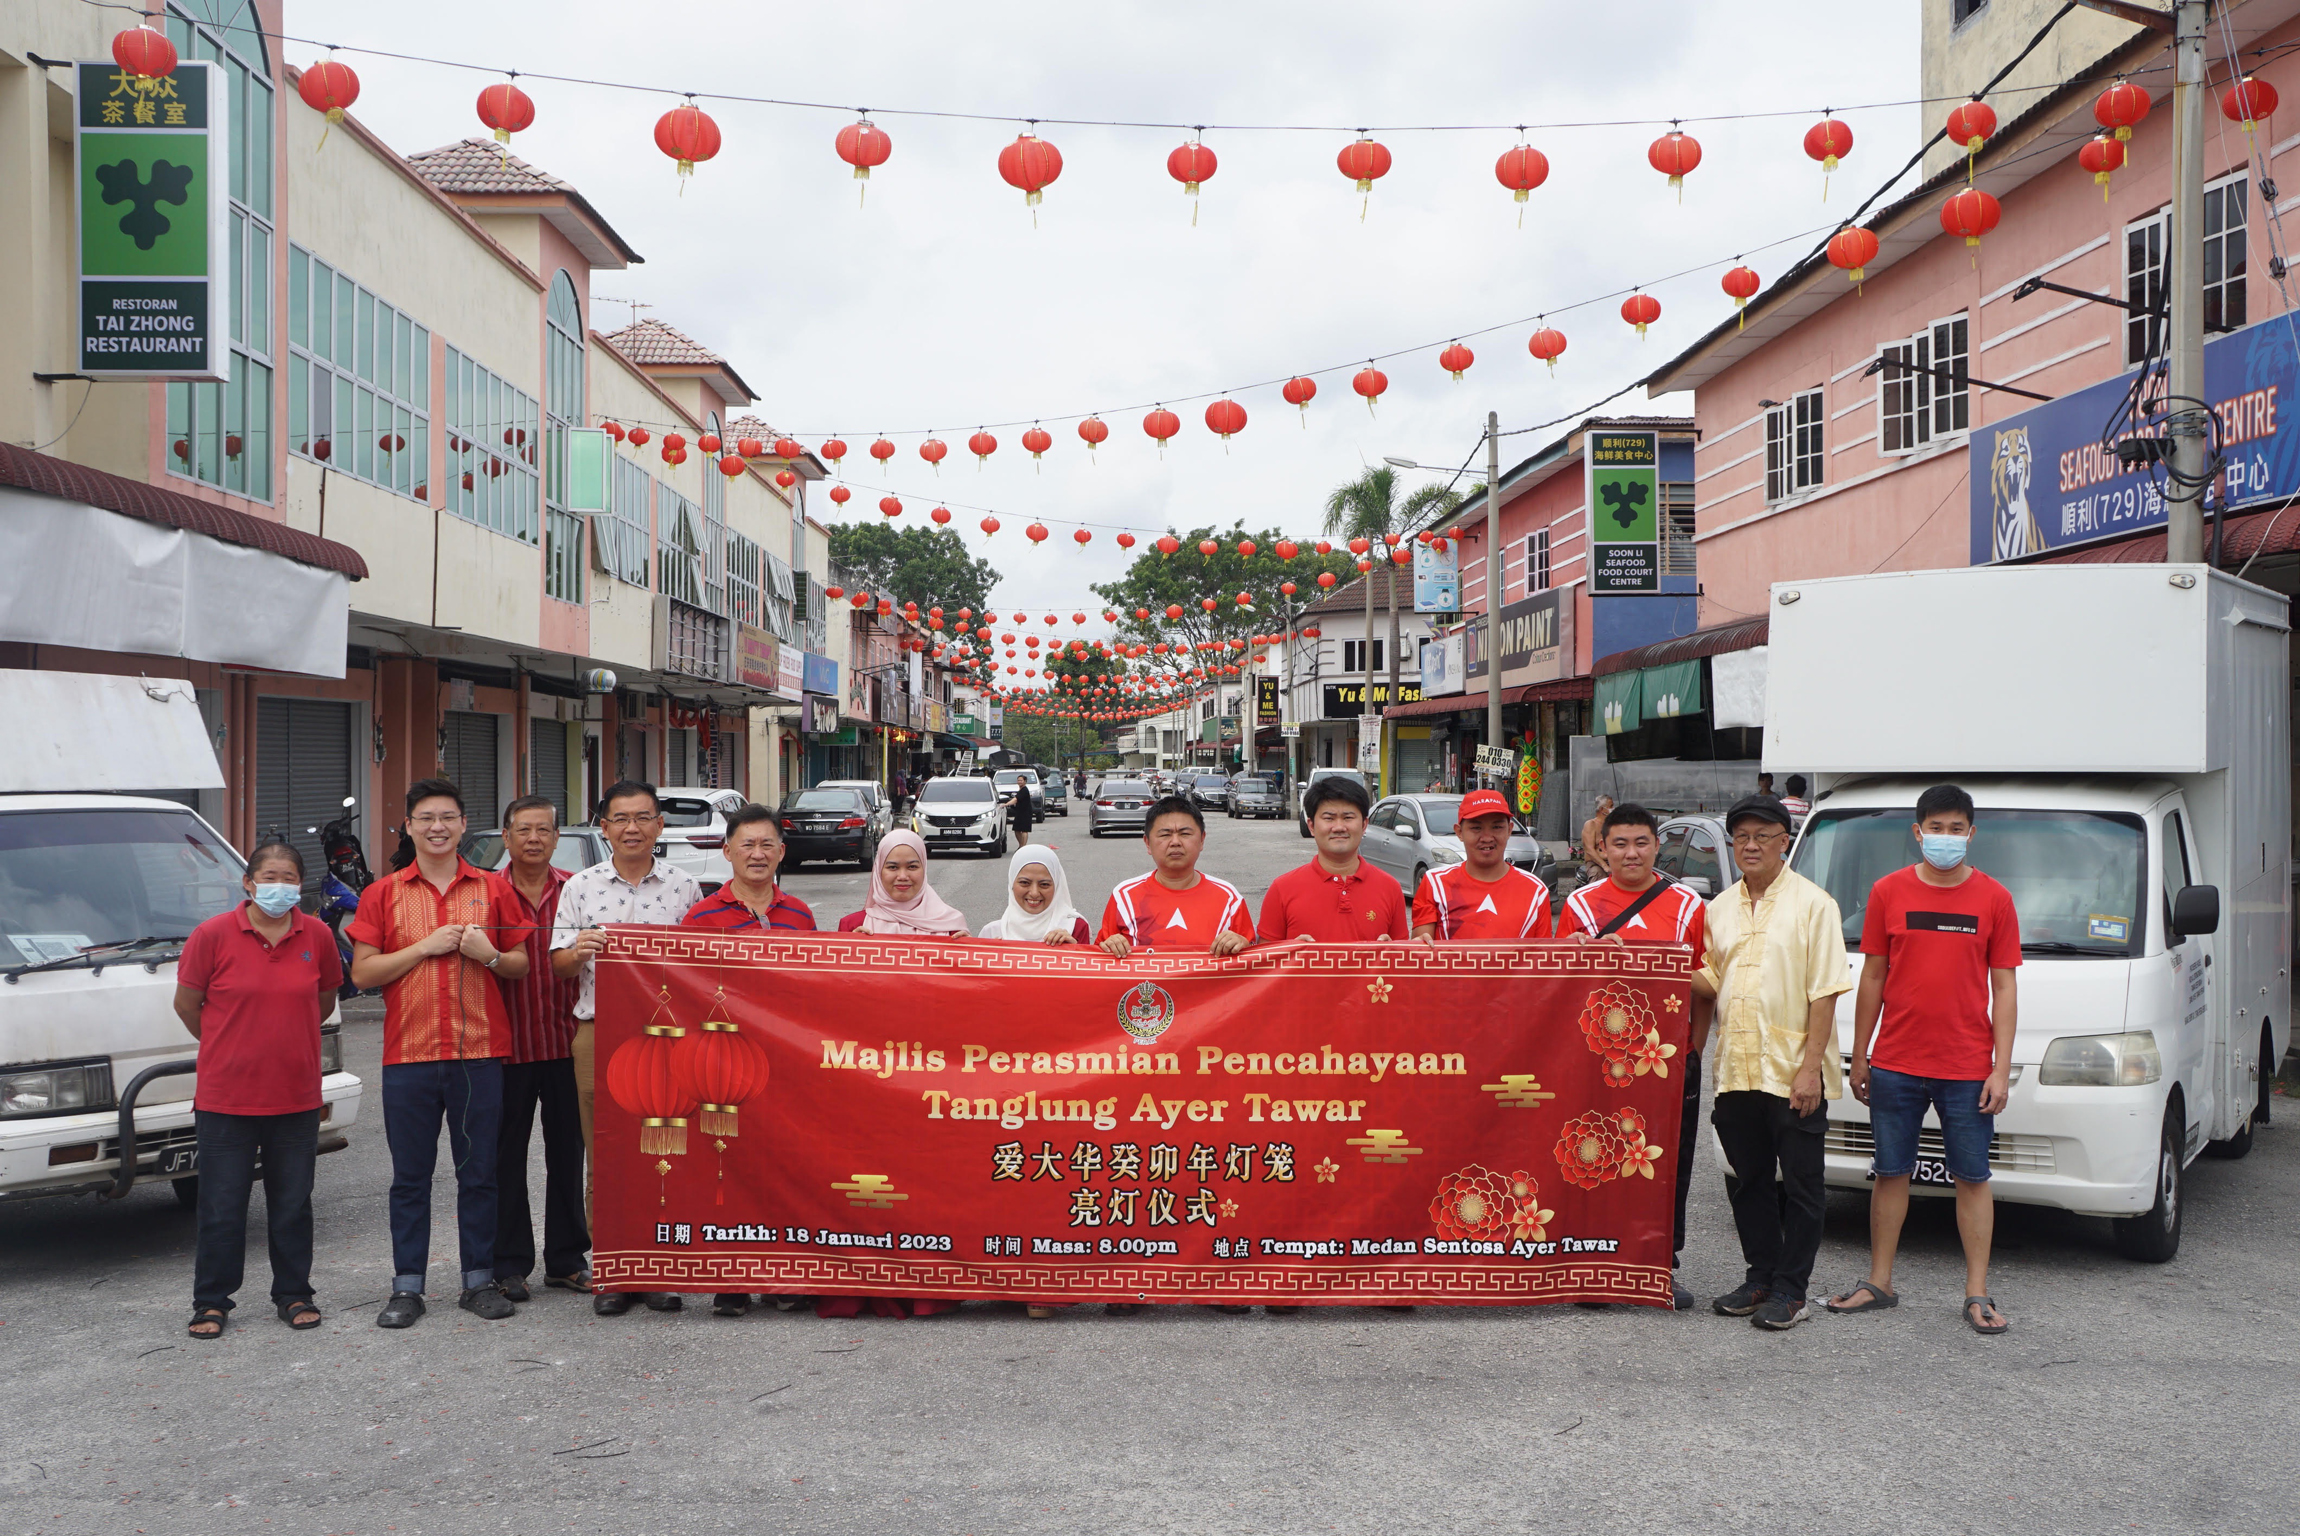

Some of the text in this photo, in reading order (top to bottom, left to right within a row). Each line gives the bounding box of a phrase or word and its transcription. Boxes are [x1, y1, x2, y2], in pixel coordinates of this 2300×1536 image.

[109, 68, 178, 99] 大众
[102, 101, 187, 125] 茶餐室
[112, 299, 178, 310] RESTORAN
[96, 315, 195, 331] TAI ZHONG
[86, 337, 203, 353] RESTAURANT
[2212, 385, 2278, 450] CENTRE
[2060, 438, 2115, 492] SEAFOOD
[1605, 559, 1646, 567] SEAFOOD
[1608, 549, 1643, 557] SOON LI
[1598, 568, 1653, 576] FOOD COURT
[1477, 607, 1553, 662] NION PAINT
[1263, 682, 1274, 690] YU
[1338, 687, 1356, 702] Yu
[1476, 754, 1512, 768] 244 0330
[1488, 747, 1503, 757] 010
[820, 1040, 1468, 1082] Majlis Perasmian Pencahayaan
[921, 1090, 1367, 1130] Tanglung Ayer Tawar
[165, 1150, 199, 1173] JFY
[993, 1142, 1296, 1183] 爱大华癸卯年灯笼
[1070, 1187, 1218, 1228] 亮灯仪式
[656, 1224, 952, 1251] 日期 Tarikh: 18 Januari 2023
[985, 1236, 1178, 1257] 时间 Masa: 8.00pm
[1213, 1236, 1619, 1259] 地点 Tempat: Medan Sentosa Ayer Tawar
